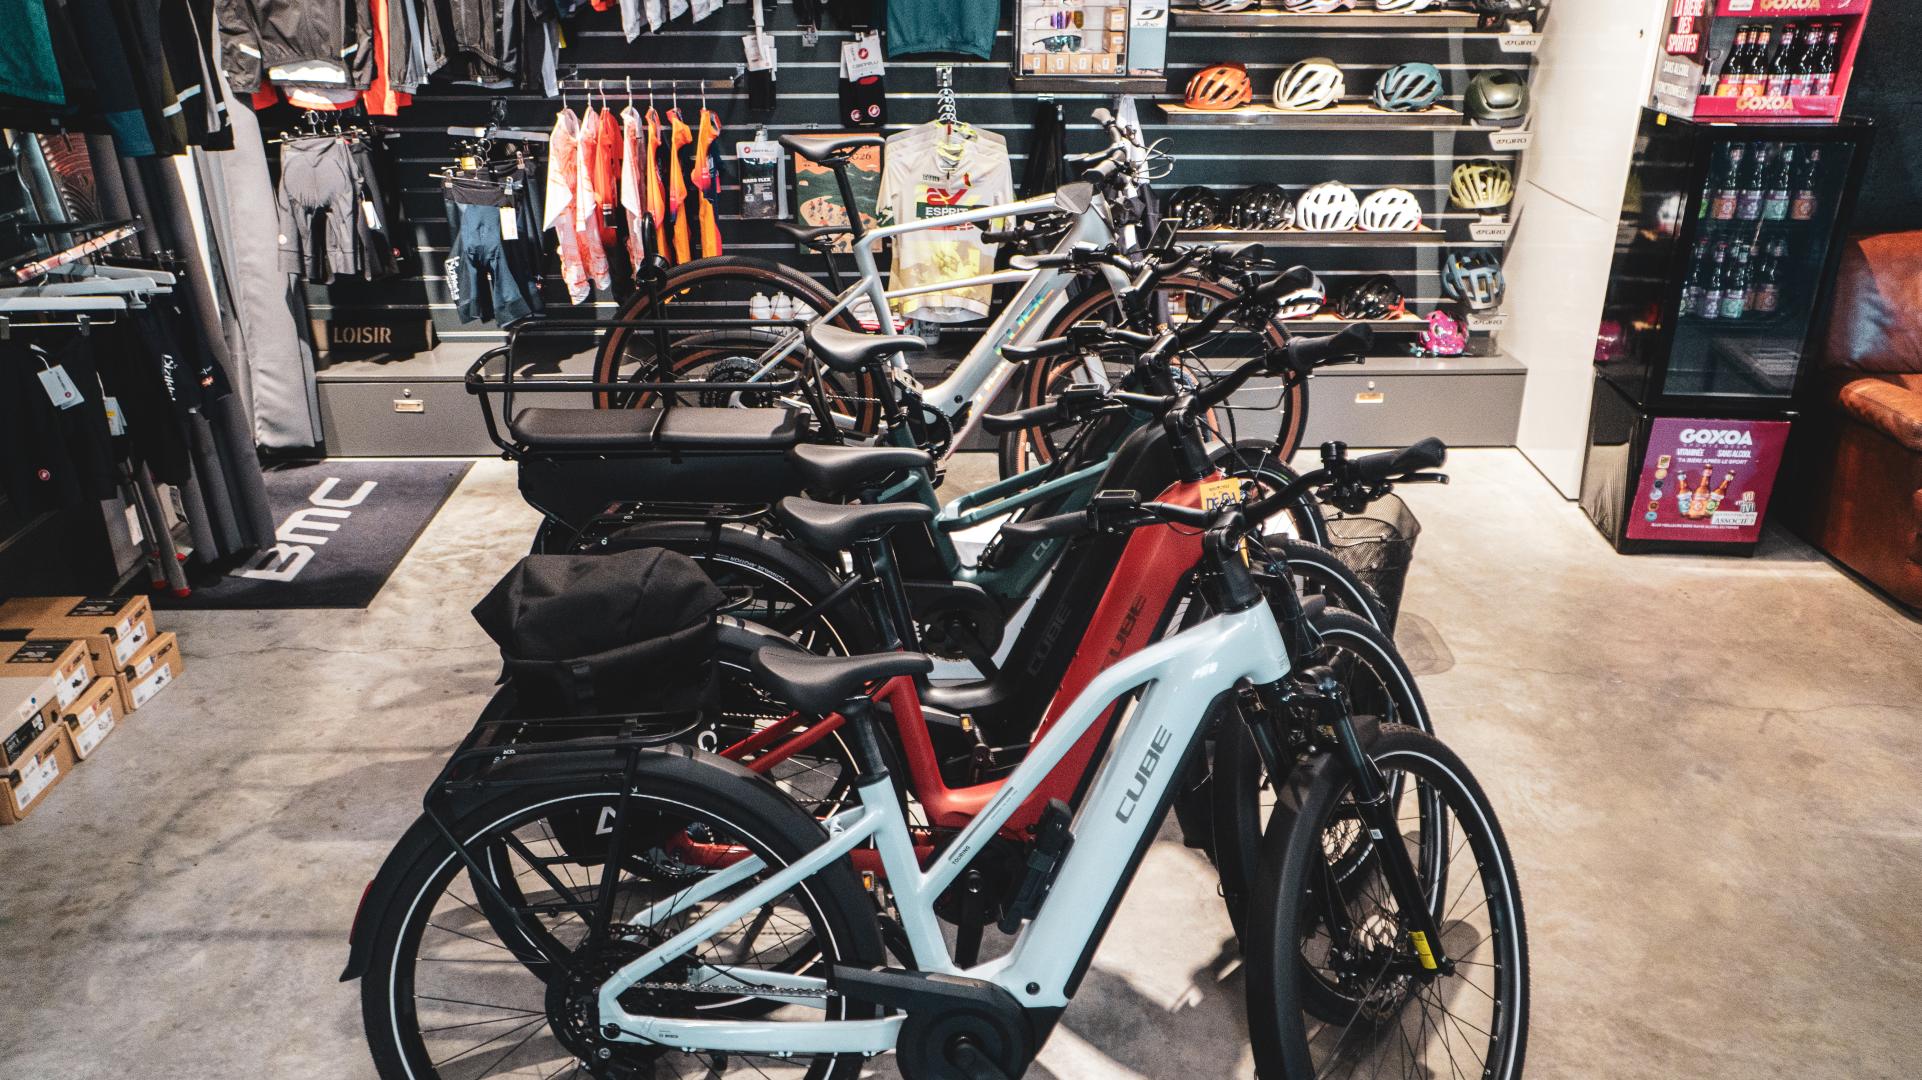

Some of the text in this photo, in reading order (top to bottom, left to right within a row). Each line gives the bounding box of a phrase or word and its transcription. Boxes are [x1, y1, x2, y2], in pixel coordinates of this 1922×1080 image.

[1678, 17, 1693, 34] DES
[1667, 34, 1698, 53] SPORTIFS
[1736, 96, 1794, 111] GOXOA
[333, 326, 392, 344] LOISIR
[1680, 428, 1753, 446] GOXOA
[229, 477, 378, 583] BMC
[1115, 725, 1173, 824] CUBE
[952, 845, 971, 865] TOURING
